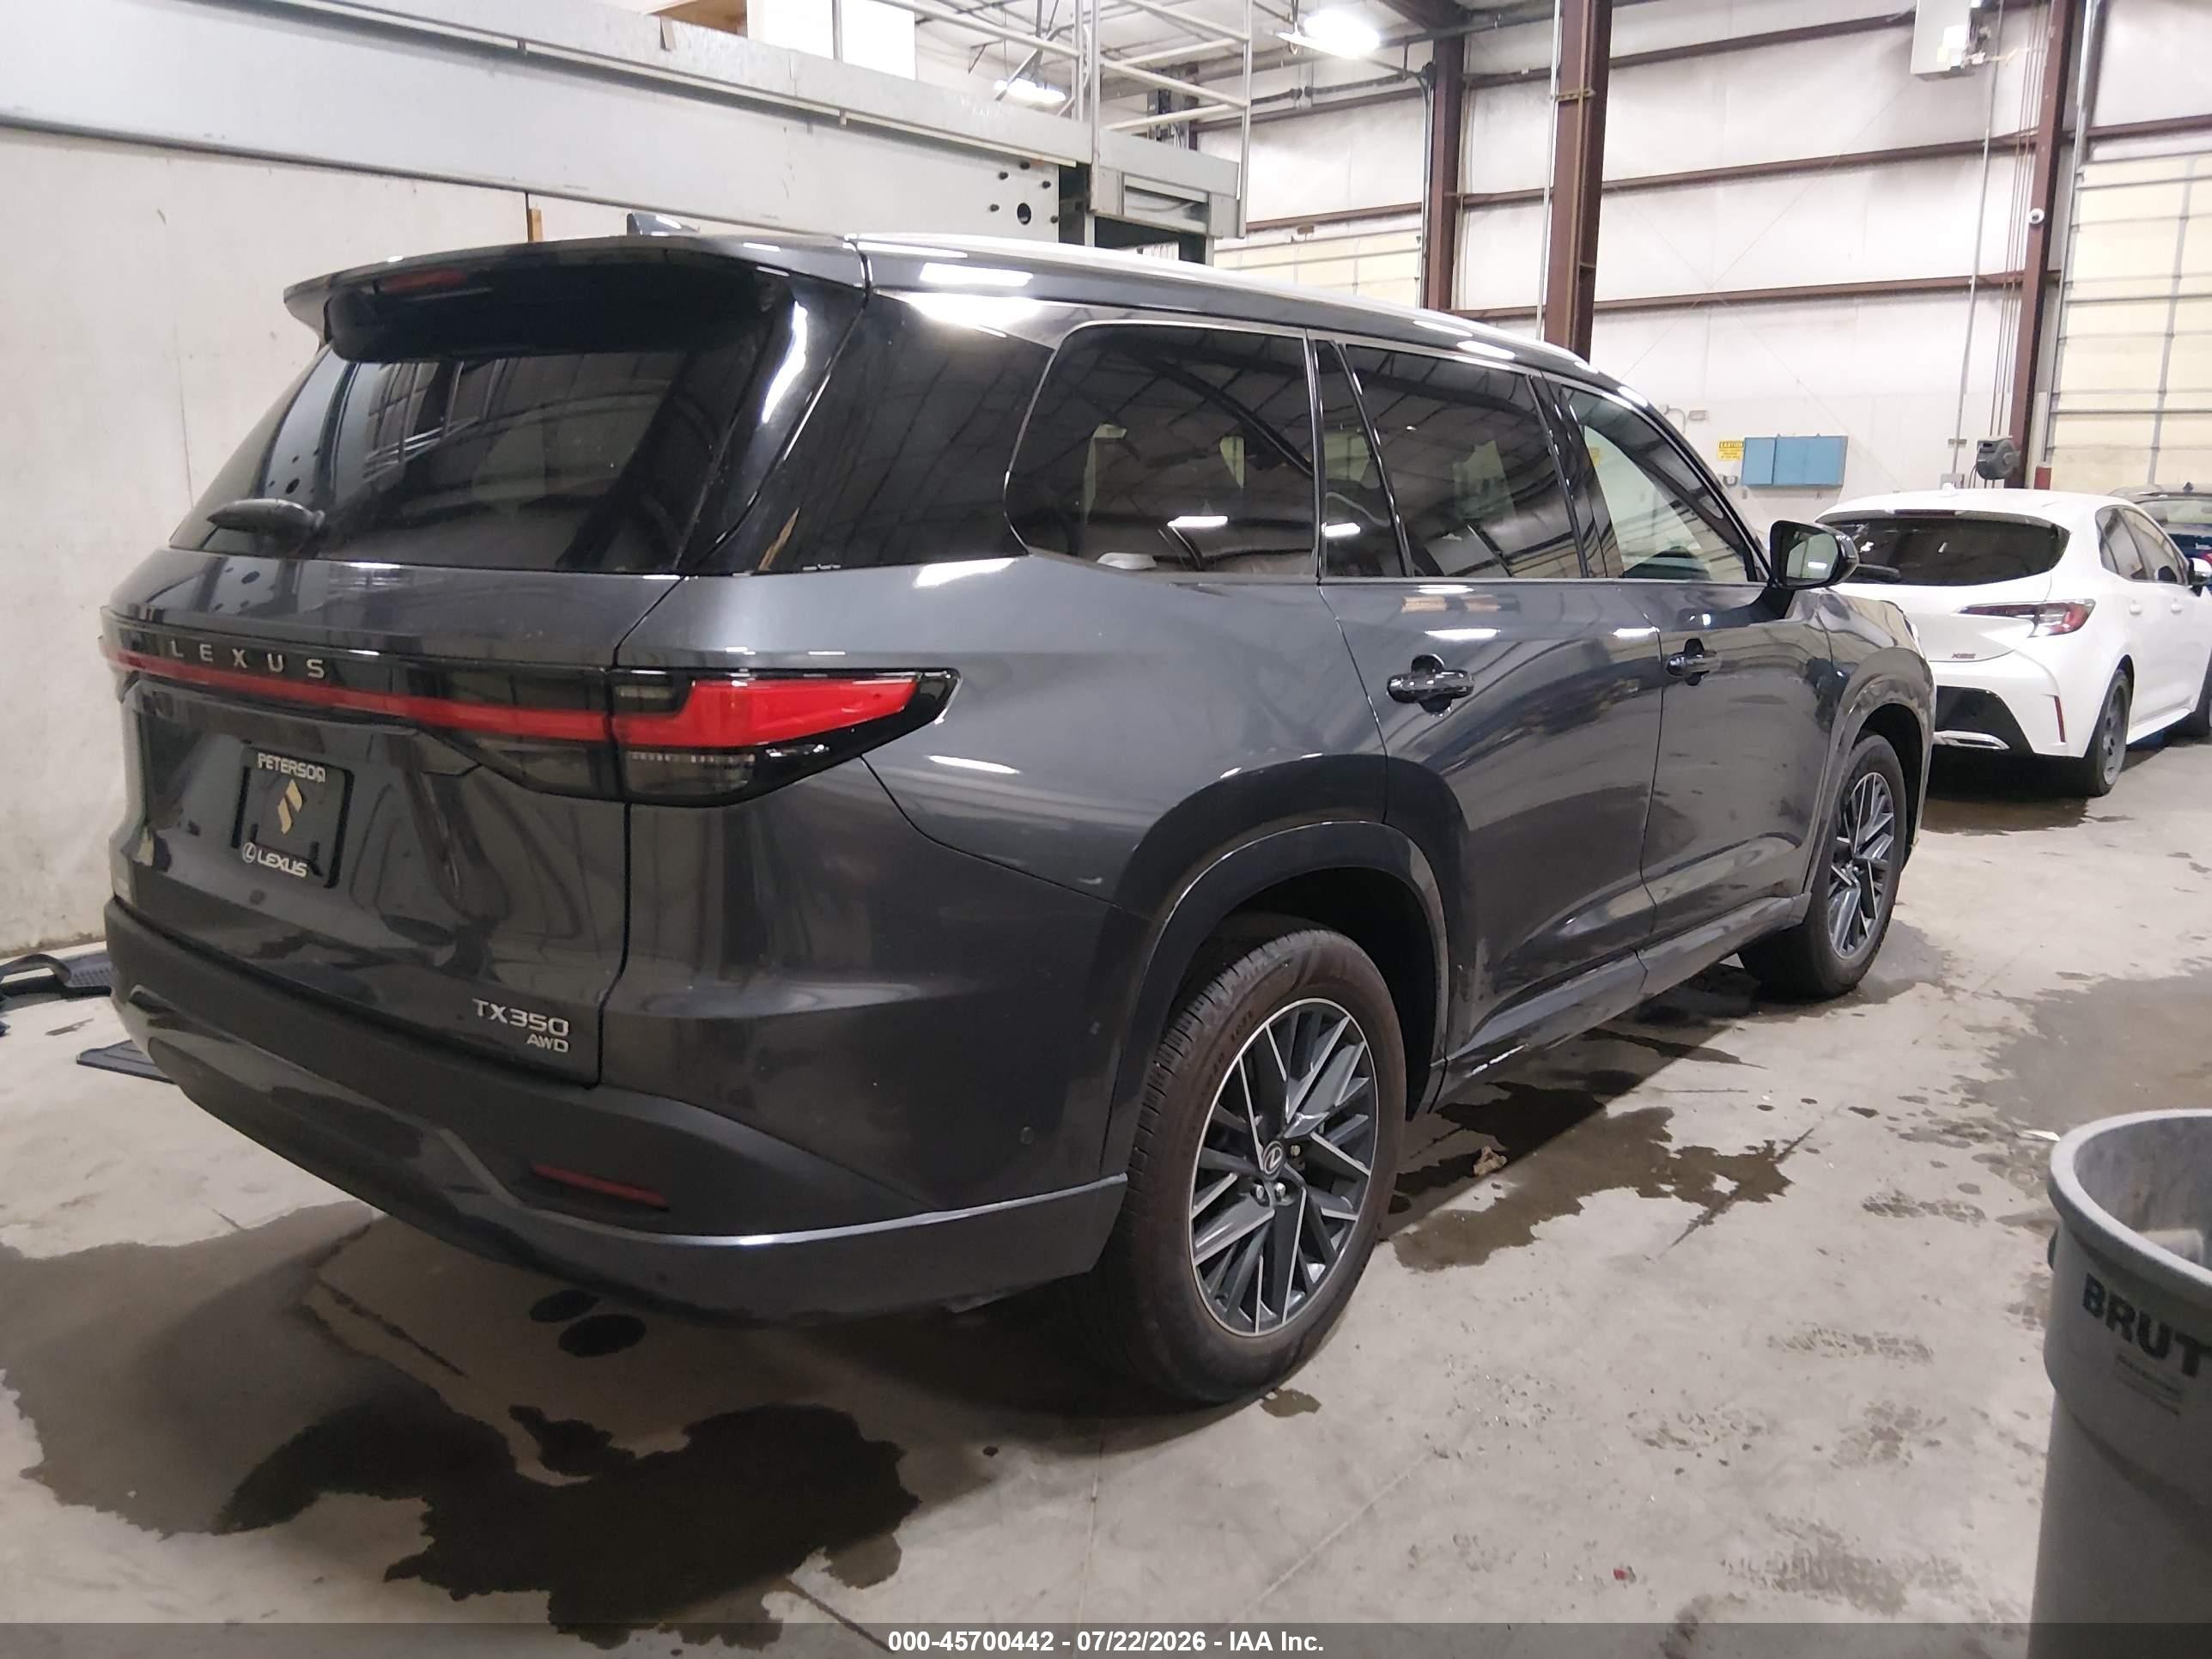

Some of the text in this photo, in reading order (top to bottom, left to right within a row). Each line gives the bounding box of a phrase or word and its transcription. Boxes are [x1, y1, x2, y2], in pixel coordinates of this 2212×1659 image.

[171, 640, 325, 678] LEXUS
[258, 752, 326, 783] PETERSON
[258, 849, 307, 878] LEXUS
[471, 998, 569, 1037] TX350
[526, 1033, 569, 1053] AWD
